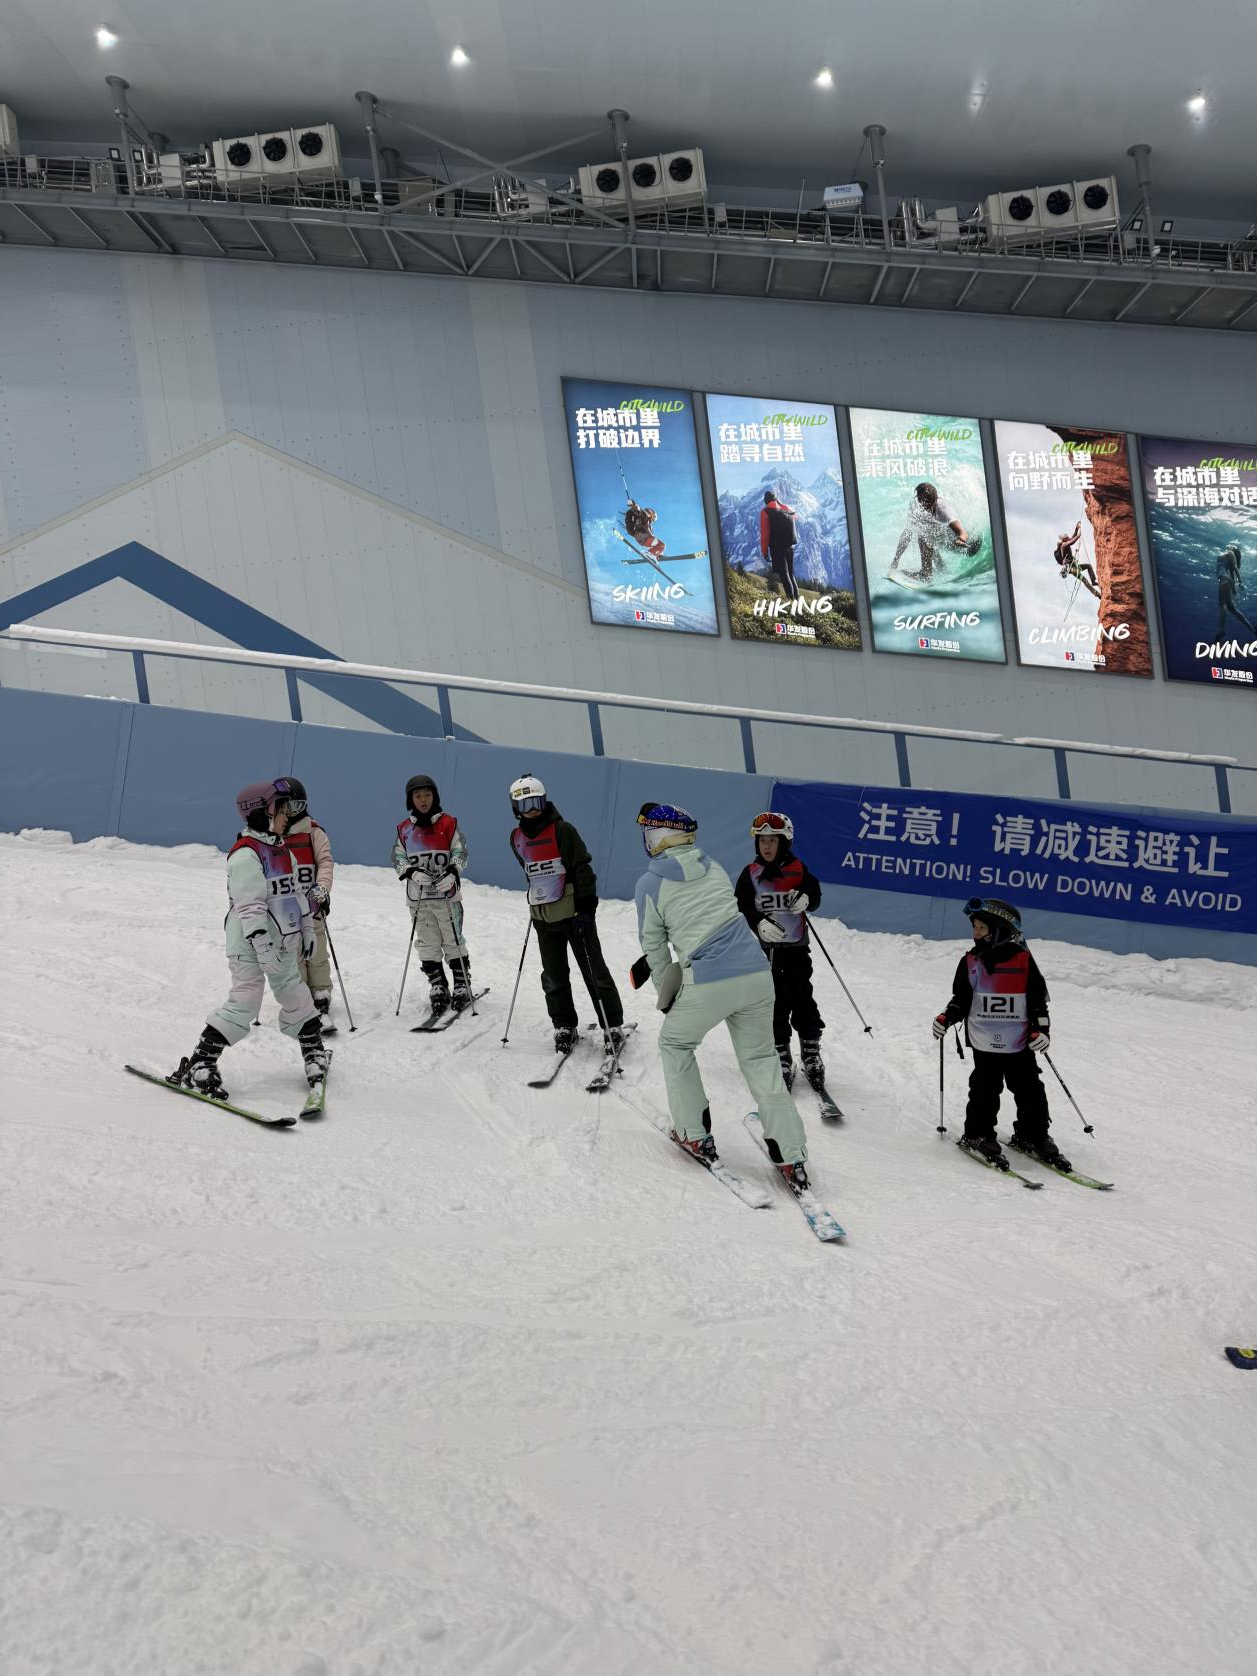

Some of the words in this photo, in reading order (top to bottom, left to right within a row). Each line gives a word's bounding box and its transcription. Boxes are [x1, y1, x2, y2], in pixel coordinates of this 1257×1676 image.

[576, 408, 660, 427] 在城市里
[576, 429, 661, 448] 打破边界
[718, 423, 804, 442] 在城市里
[720, 444, 805, 463] 踏寻自然
[862, 438, 948, 456] 在城市里
[862, 458, 949, 477] 乘风破浪
[1007, 450, 1093, 469] 在城市里
[1008, 470, 1095, 490] 向野而生
[1154, 466, 1240, 485] 在城市里
[1156, 486, 1257, 506] 与深海对话
[612, 582, 684, 602] SKIING
[753, 596, 832, 617] HIKING
[894, 612, 980, 630] SURFING
[1028, 622, 1130, 644] CLIMBING
[842, 852, 971, 882] ATTENTION!
[980, 866, 1050, 890] SLOW
[1057, 875, 1132, 901] DOWN
[1140, 886, 1156, 904] &
[1166, 888, 1242, 912] AVOID
[983, 996, 1014, 1012] 121
